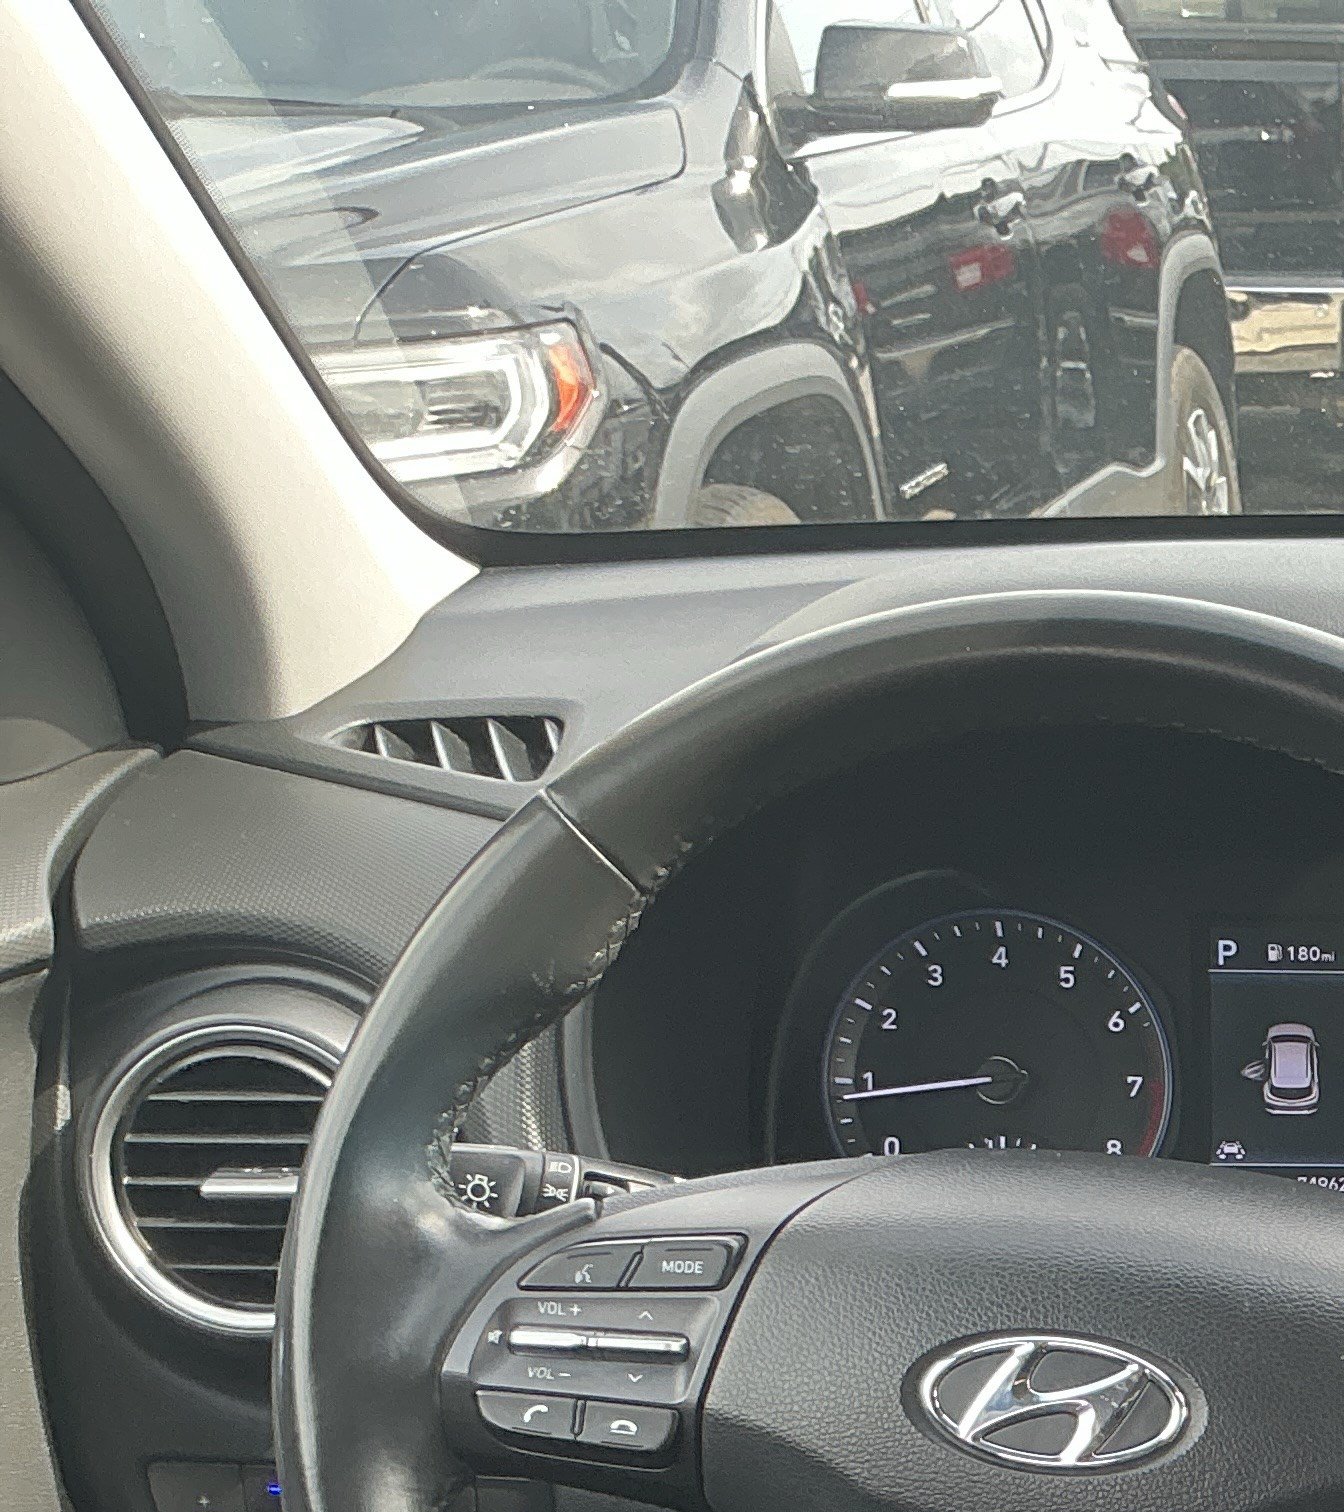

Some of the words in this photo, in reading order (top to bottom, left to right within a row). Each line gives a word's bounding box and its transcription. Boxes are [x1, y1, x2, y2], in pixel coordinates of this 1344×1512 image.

[992, 946, 1008, 968] 4
[1217, 940, 1238, 966] P
[926, 966, 943, 987] 3
[1058, 966, 1075, 989] 5
[881, 1009, 898, 1030] 2
[1108, 1011, 1125, 1033] 6
[862, 1071, 875, 1090] 1
[1126, 1076, 1144, 1098] 7
[883, 1136, 900, 1156] 0
[661, 1260, 704, 1275] MODE
